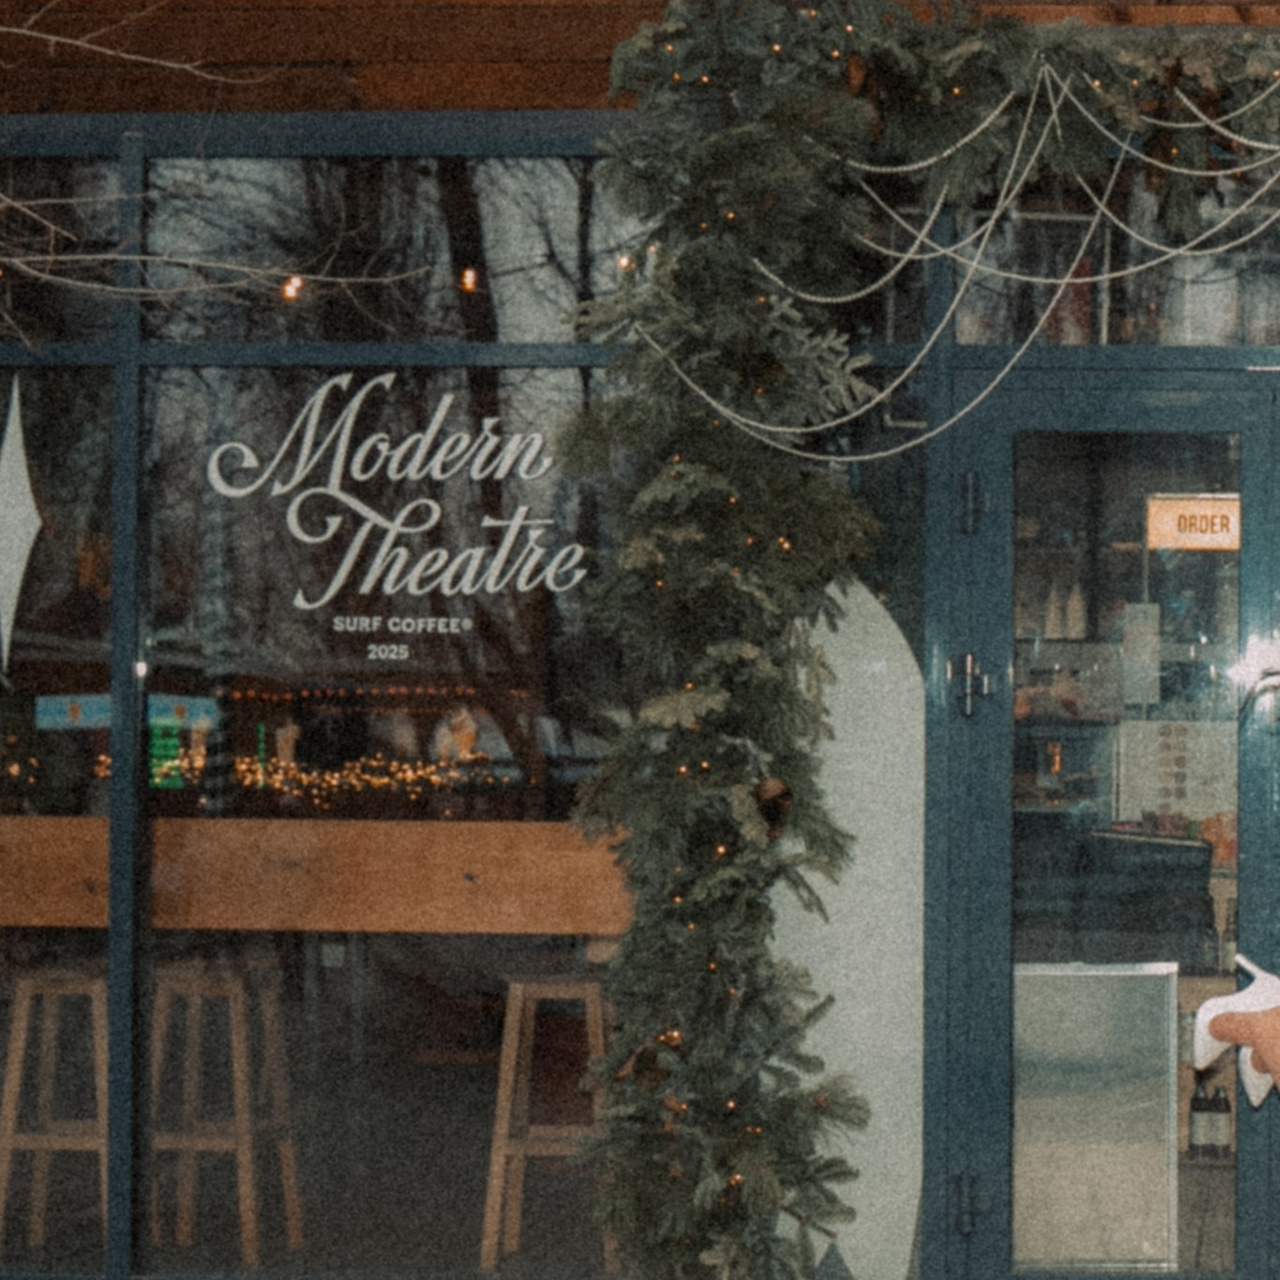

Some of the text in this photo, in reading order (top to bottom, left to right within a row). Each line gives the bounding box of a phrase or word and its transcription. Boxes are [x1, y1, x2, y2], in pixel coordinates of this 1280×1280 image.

[208, 372, 553, 497] Modern
[1177, 514, 1231, 534] ORDER
[286, 486, 588, 610] Theatre
[333, 617, 382, 632] SURF
[367, 644, 409, 660] 2025
